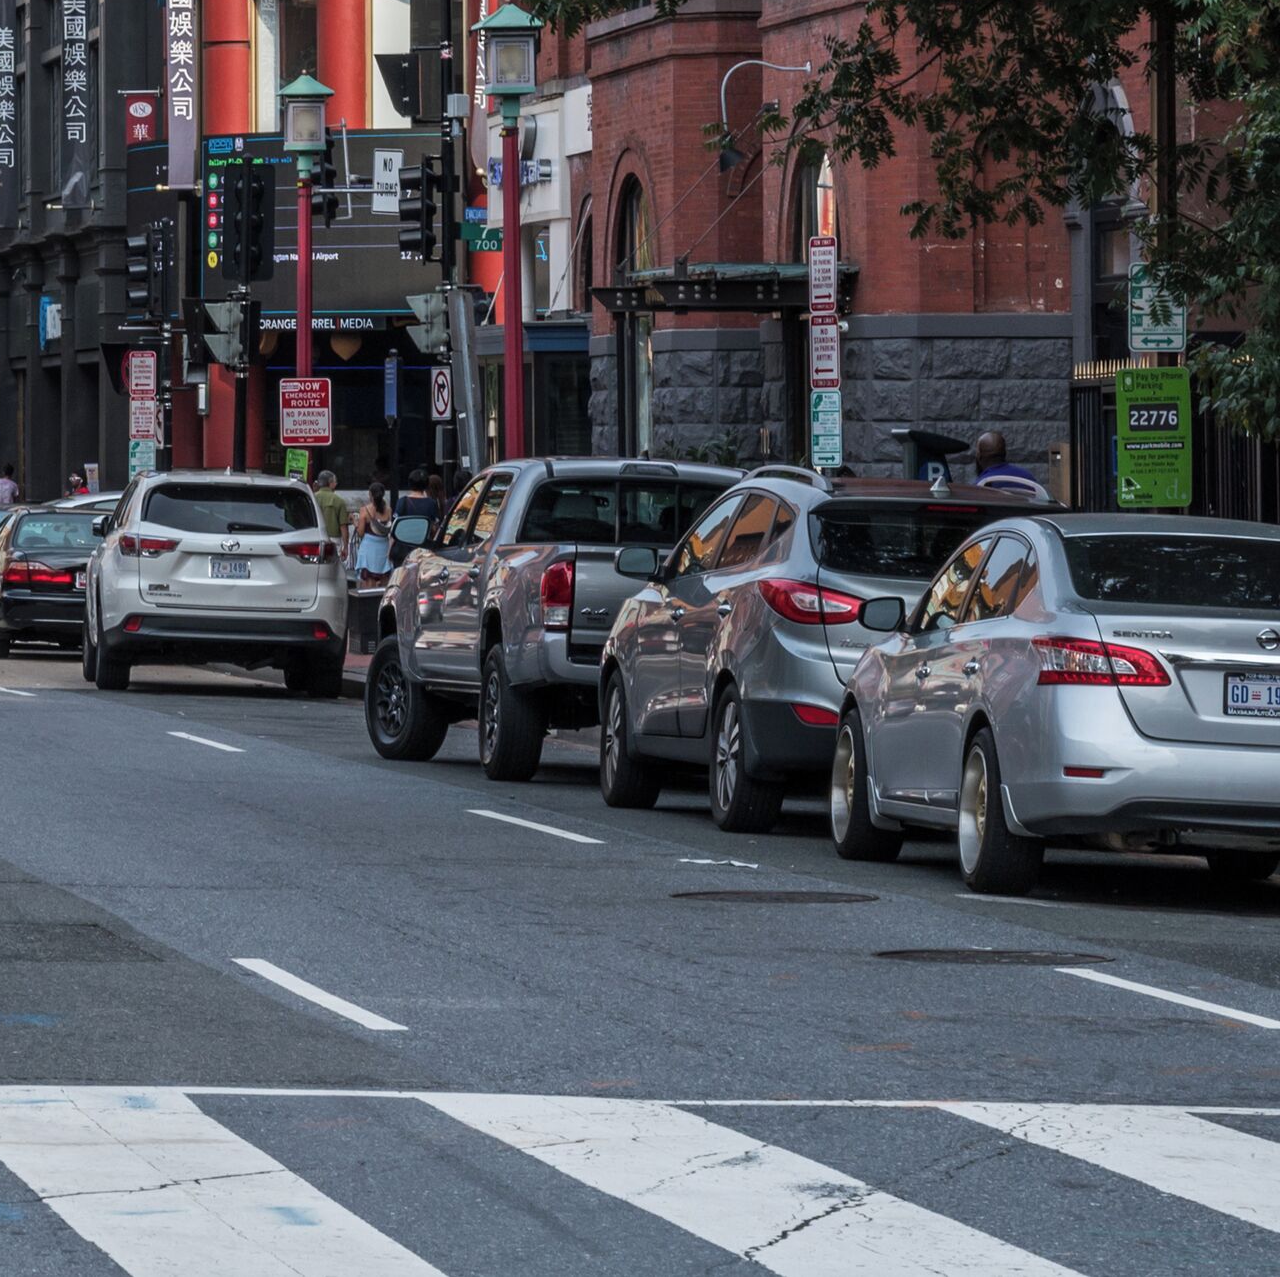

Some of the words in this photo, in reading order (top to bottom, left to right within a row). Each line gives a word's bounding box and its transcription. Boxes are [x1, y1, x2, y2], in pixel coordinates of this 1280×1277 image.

[383, 157, 393, 172] NO
[475, 240, 498, 251] 700
[316, 252, 339, 261] Airport
[311, 318, 336, 329] RREL
[340, 317, 374, 329] MEDIA
[1151, 373, 1159, 381] by
[1161, 372, 1183, 380] Phone
[298, 382, 320, 390] NOW
[1136, 382, 1163, 390] Parking
[297, 410, 326, 418] PARKING
[1130, 411, 1178, 425] 22776
[1112, 629, 1174, 640] SENTRA
[1231, 684, 1249, 704] GD
